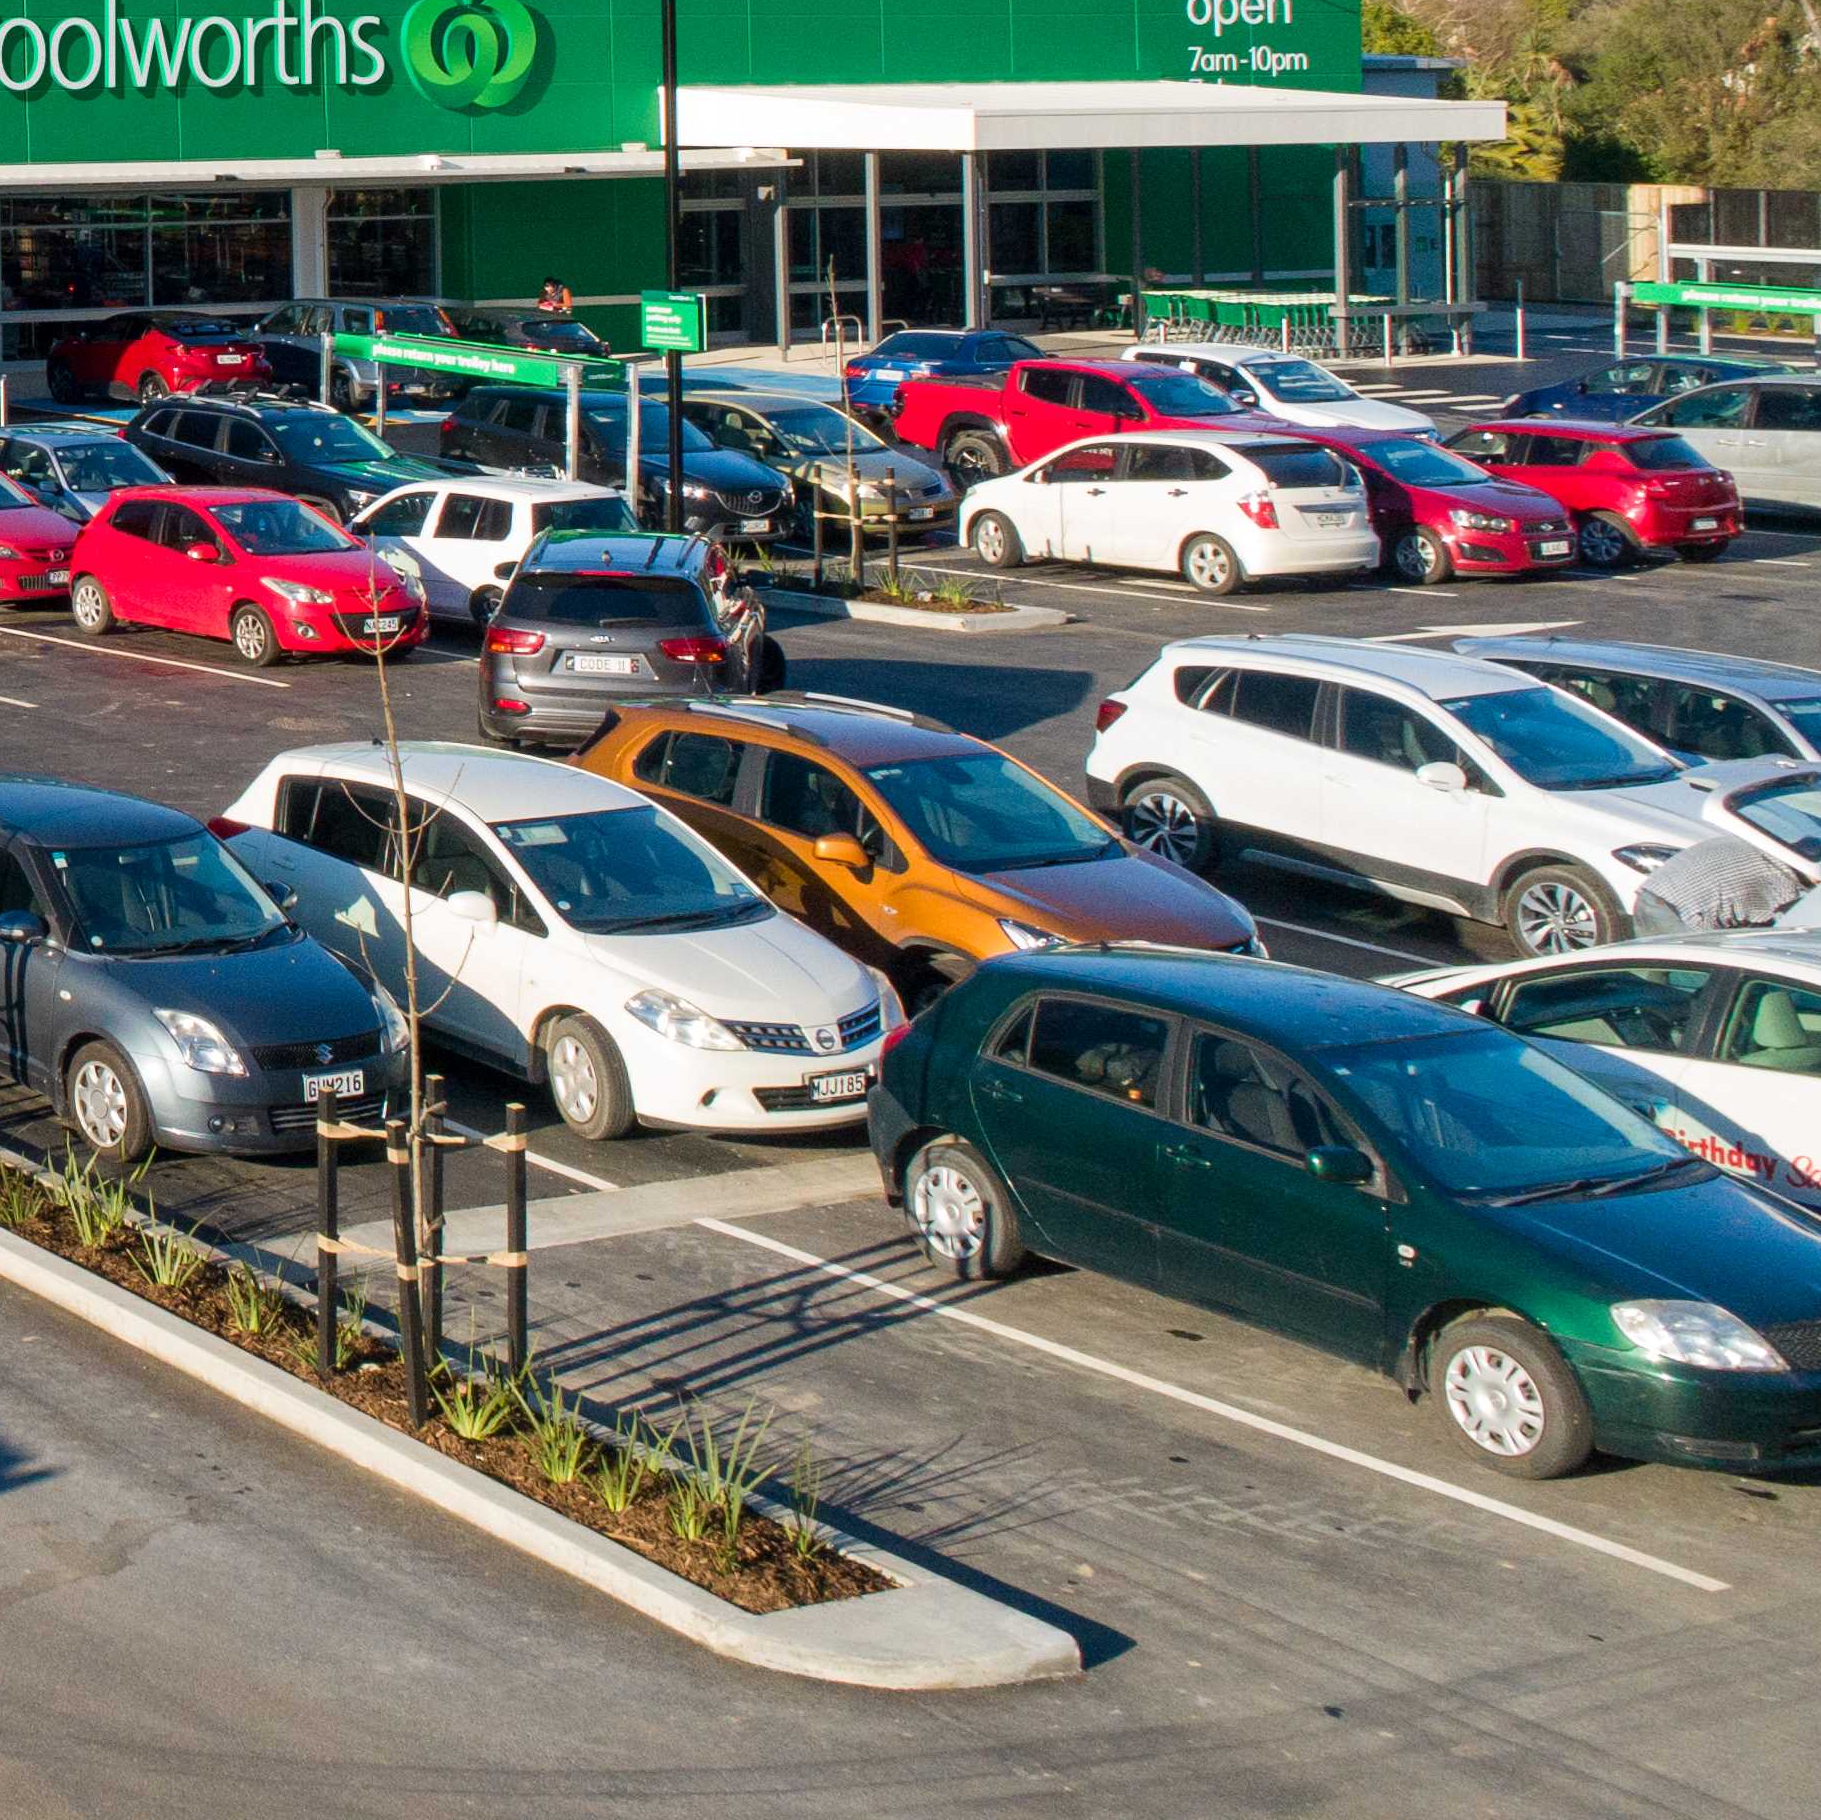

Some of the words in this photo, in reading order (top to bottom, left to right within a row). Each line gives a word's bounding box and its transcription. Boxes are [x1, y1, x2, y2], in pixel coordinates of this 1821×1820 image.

[372, 343, 403, 359] please
[404, 348, 434, 362] return
[434, 353, 457, 366] your
[457, 354, 490, 373] trolley
[491, 357, 516, 375] here
[579, 658, 612, 671] CODE
